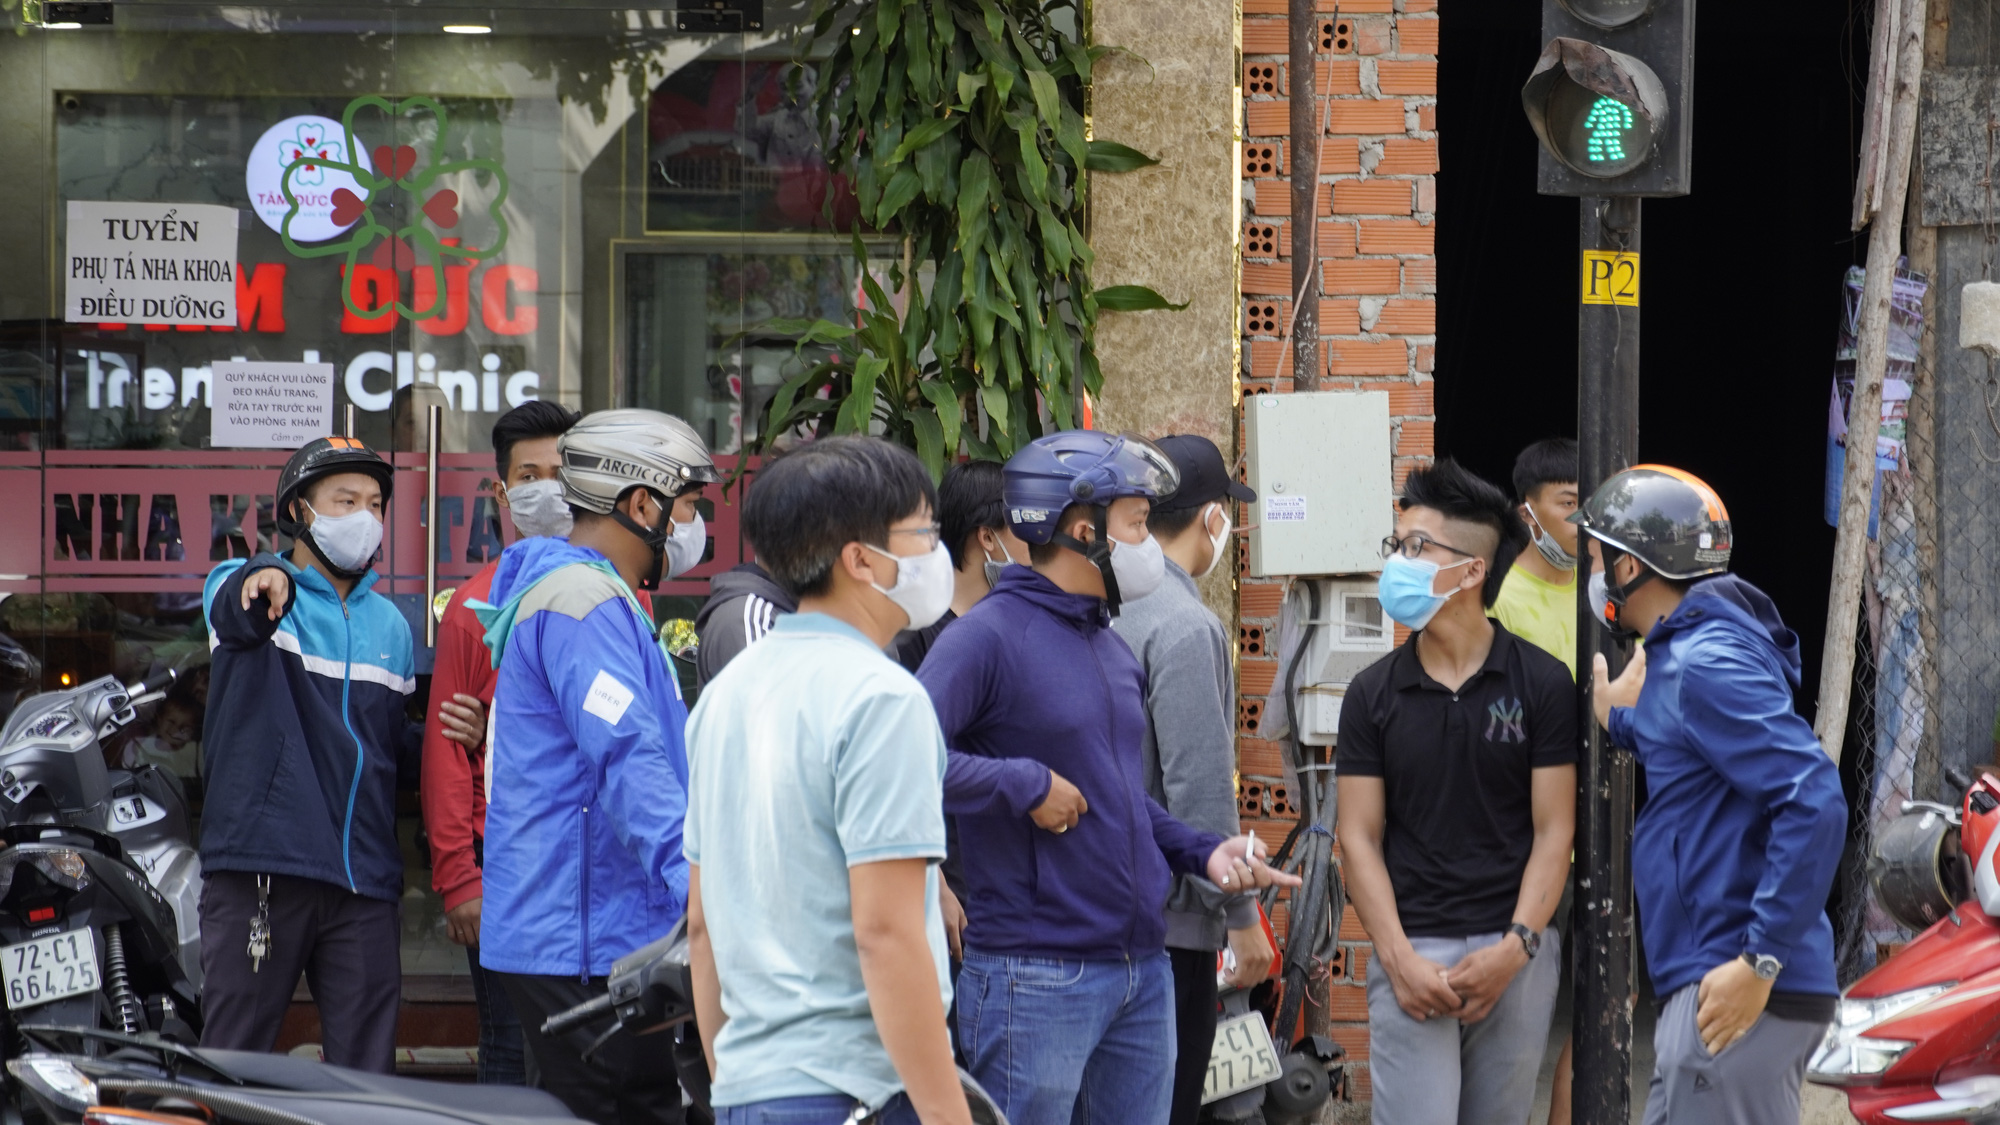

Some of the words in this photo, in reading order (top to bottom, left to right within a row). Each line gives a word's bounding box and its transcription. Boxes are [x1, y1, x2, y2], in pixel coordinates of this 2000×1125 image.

[103, 208, 199, 242] TUYỂN
[72, 256, 107, 284] PHỤ
[114, 251, 136, 280] TÁ
[142, 258, 178, 281] NHA
[184, 259, 232, 282] KHOA
[1587, 259, 1635, 298] P2
[80, 288, 135, 317] ĐIỀU
[142, 294, 225, 319] DƯỠNG
[233, 387, 253, 396] ĐEO
[283, 389, 318, 399] TRANG,
[248, 372, 279, 383] KHÁCH
[282, 375, 298, 383] VUI
[300, 374, 327, 384] LÒNG
[228, 400, 249, 411] RỬA
[252, 403, 269, 412] TAY
[272, 402, 304, 413] TRƯỚC
[307, 405, 322, 413] KHI
[230, 416, 250, 426] VÀO
[253, 416, 286, 427] PHÒNG
[291, 417, 320, 427] KHÁM
[271, 432, 290, 442] Cảm
[601, 458, 651, 480] ARCTIC
[653, 472, 676, 490] CAT
[54, 494, 185, 561] NHA
[594, 688, 620, 707] UBER
[32, 926, 61, 938] HONDA
[14, 935, 79, 974] 72-C1
[10, 961, 95, 1004] 664.25
